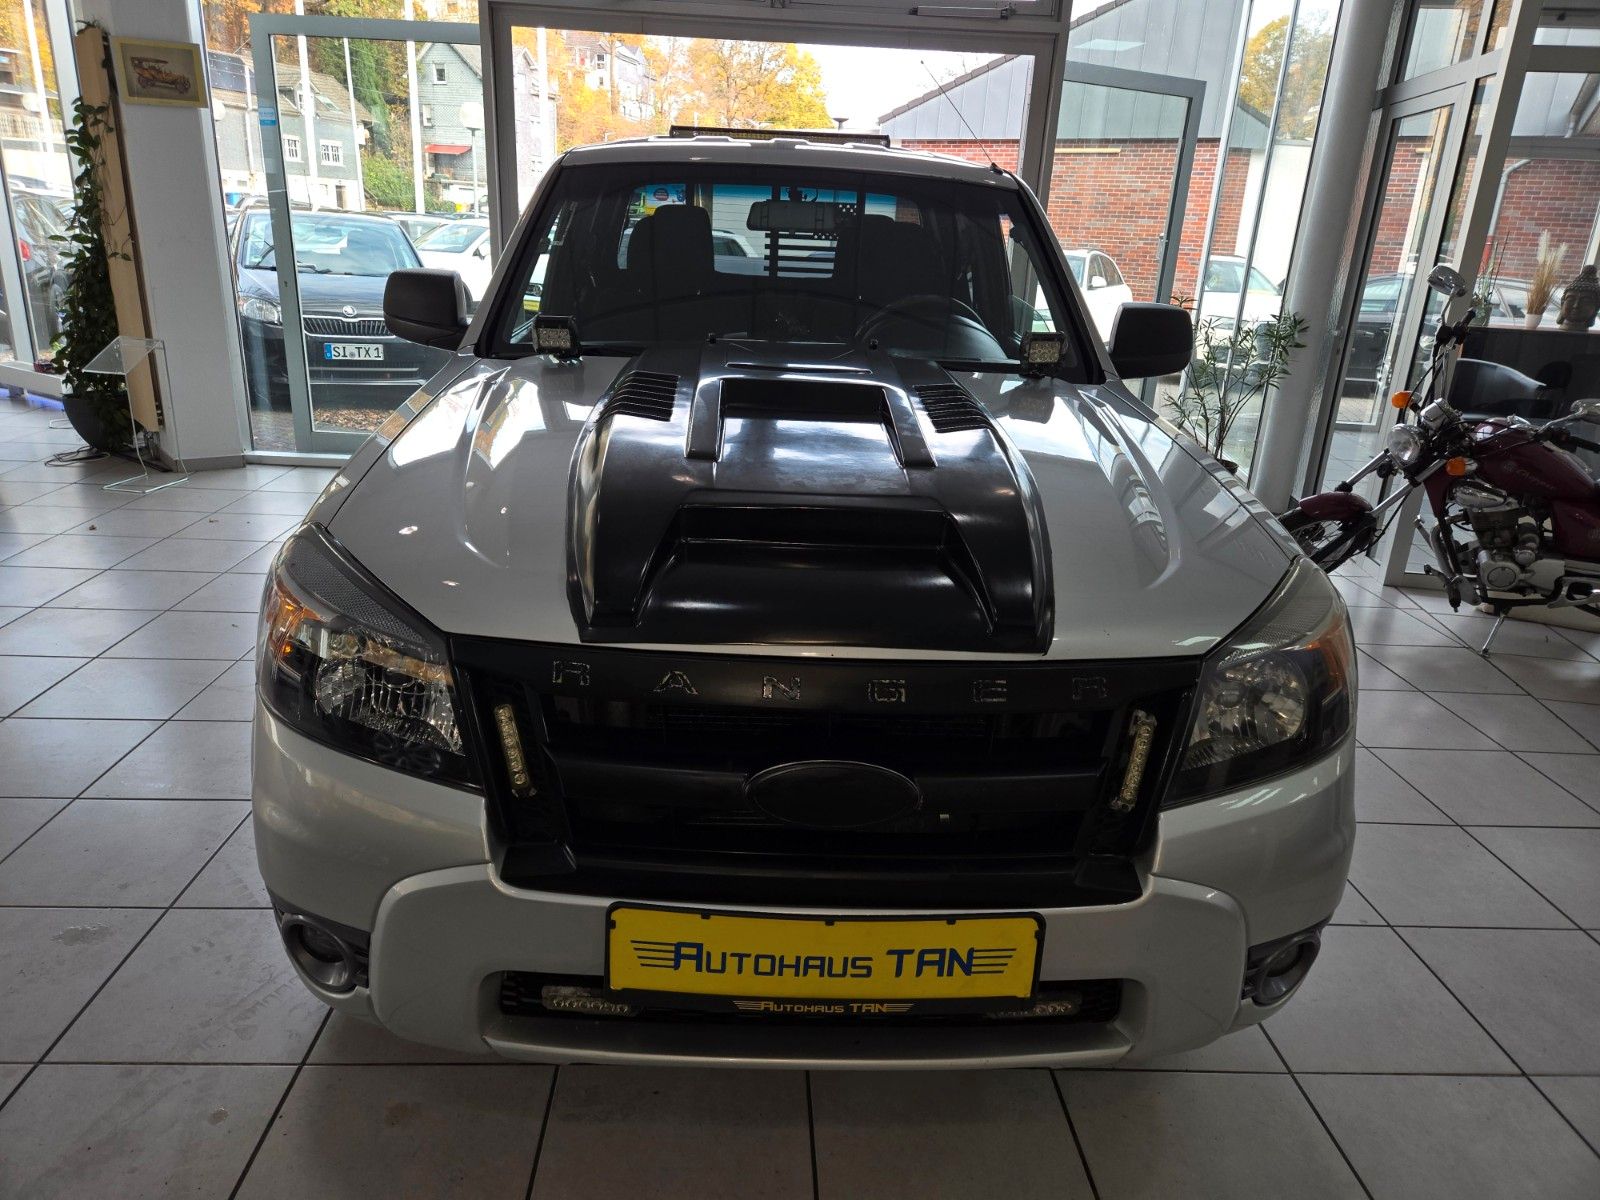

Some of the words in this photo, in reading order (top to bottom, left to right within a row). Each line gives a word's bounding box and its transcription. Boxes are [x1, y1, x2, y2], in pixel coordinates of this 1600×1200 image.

[333, 346, 348, 358] SI
[552, 659, 1108, 703] RANGER
[673, 941, 874, 979] AUTOHAUS
[886, 946, 975, 979] TAN
[850, 1003, 888, 1013] TAN
